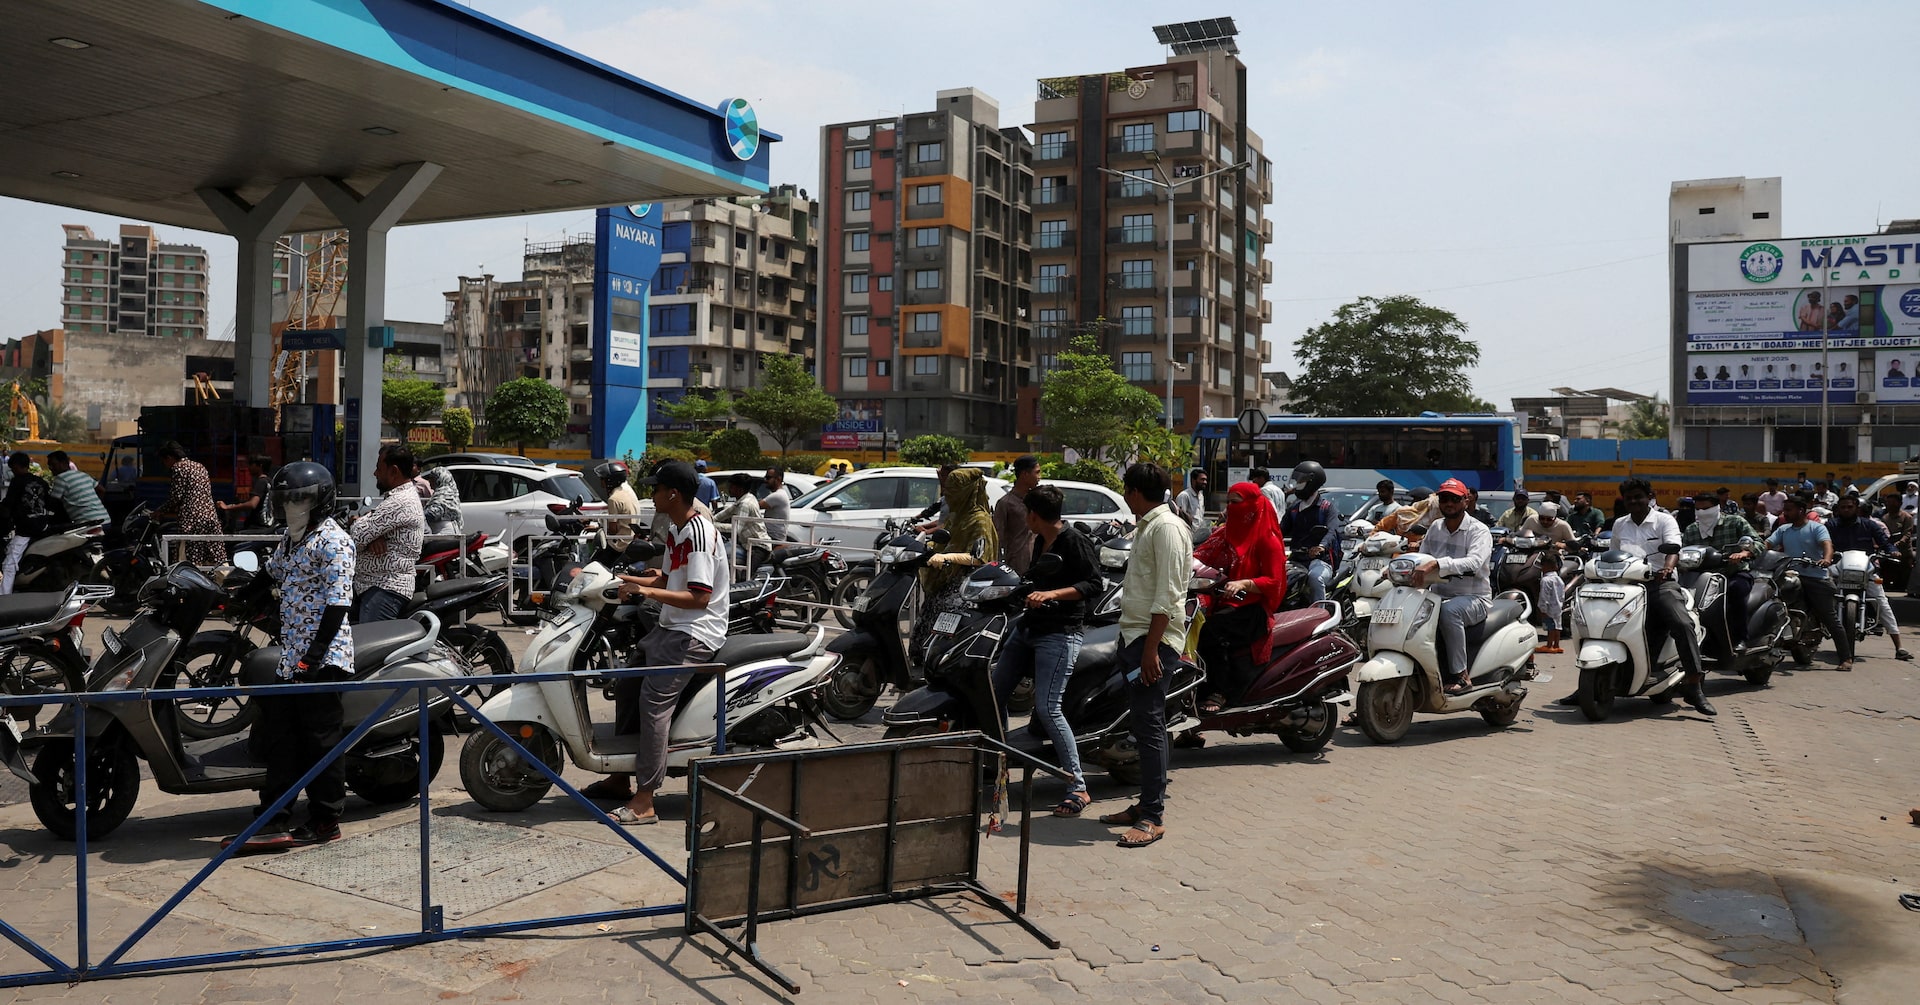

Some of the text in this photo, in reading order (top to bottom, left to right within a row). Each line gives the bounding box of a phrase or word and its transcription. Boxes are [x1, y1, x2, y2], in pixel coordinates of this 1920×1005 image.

[616, 224, 656, 247] NAYARA
[1801, 238, 1867, 247] EXCELLENT
[1801, 243, 1920, 270] MAST
[1802, 269, 1920, 282] ACAD
[1761, 340, 1797, 349] (BOARD)
[1833, 339, 1866, 347] IIT-JEE
[1872, 338, 1912, 346] GUJCET
[836, 421, 865, 430] INSIDE
[431, 427, 449, 443] BAZ
